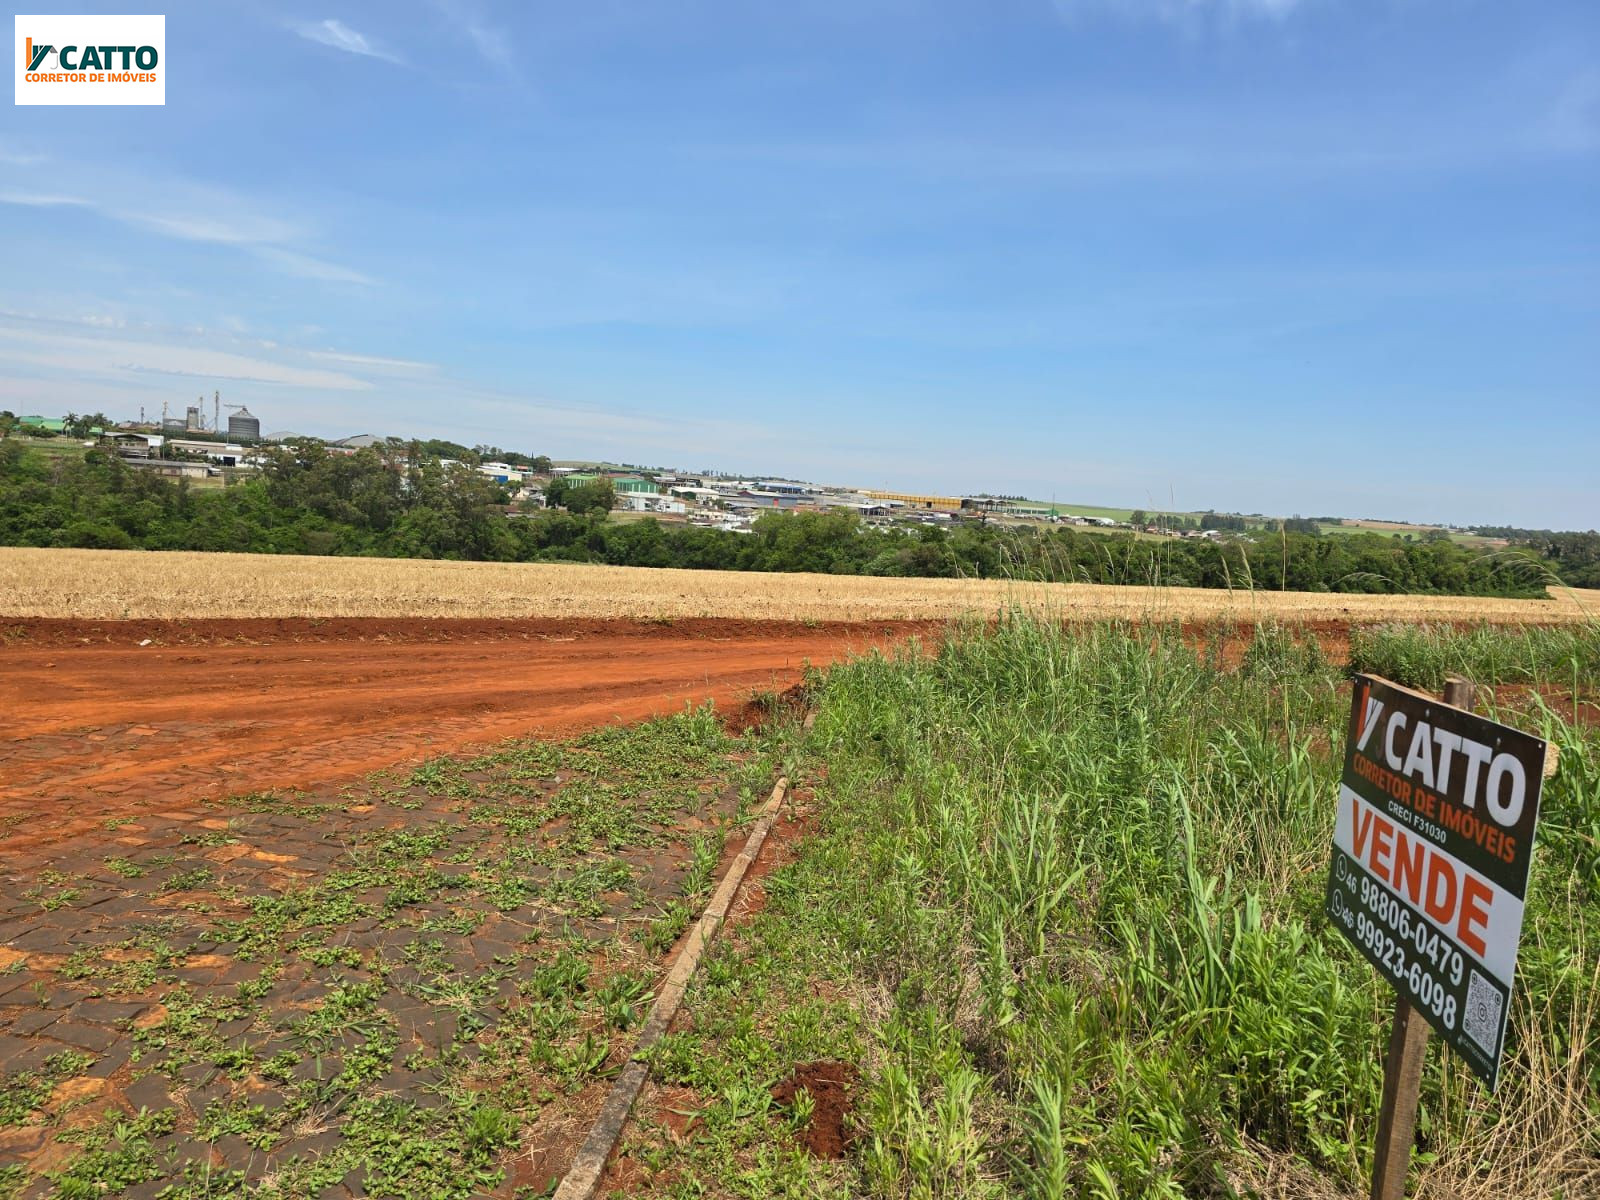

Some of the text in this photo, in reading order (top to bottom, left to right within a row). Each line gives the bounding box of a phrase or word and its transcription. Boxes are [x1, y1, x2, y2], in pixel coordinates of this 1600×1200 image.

[1353, 752, 1516, 864] CORRETOR DE IMÓVEIS
[1385, 711, 1526, 827] CATTO
[1387, 800, 1447, 844] CRECI F31030
[1345, 872, 1464, 987] 46 98806-0479
[1352, 797, 1494, 959] VENDE
[1342, 906, 1457, 1030] 46 99923-6098
